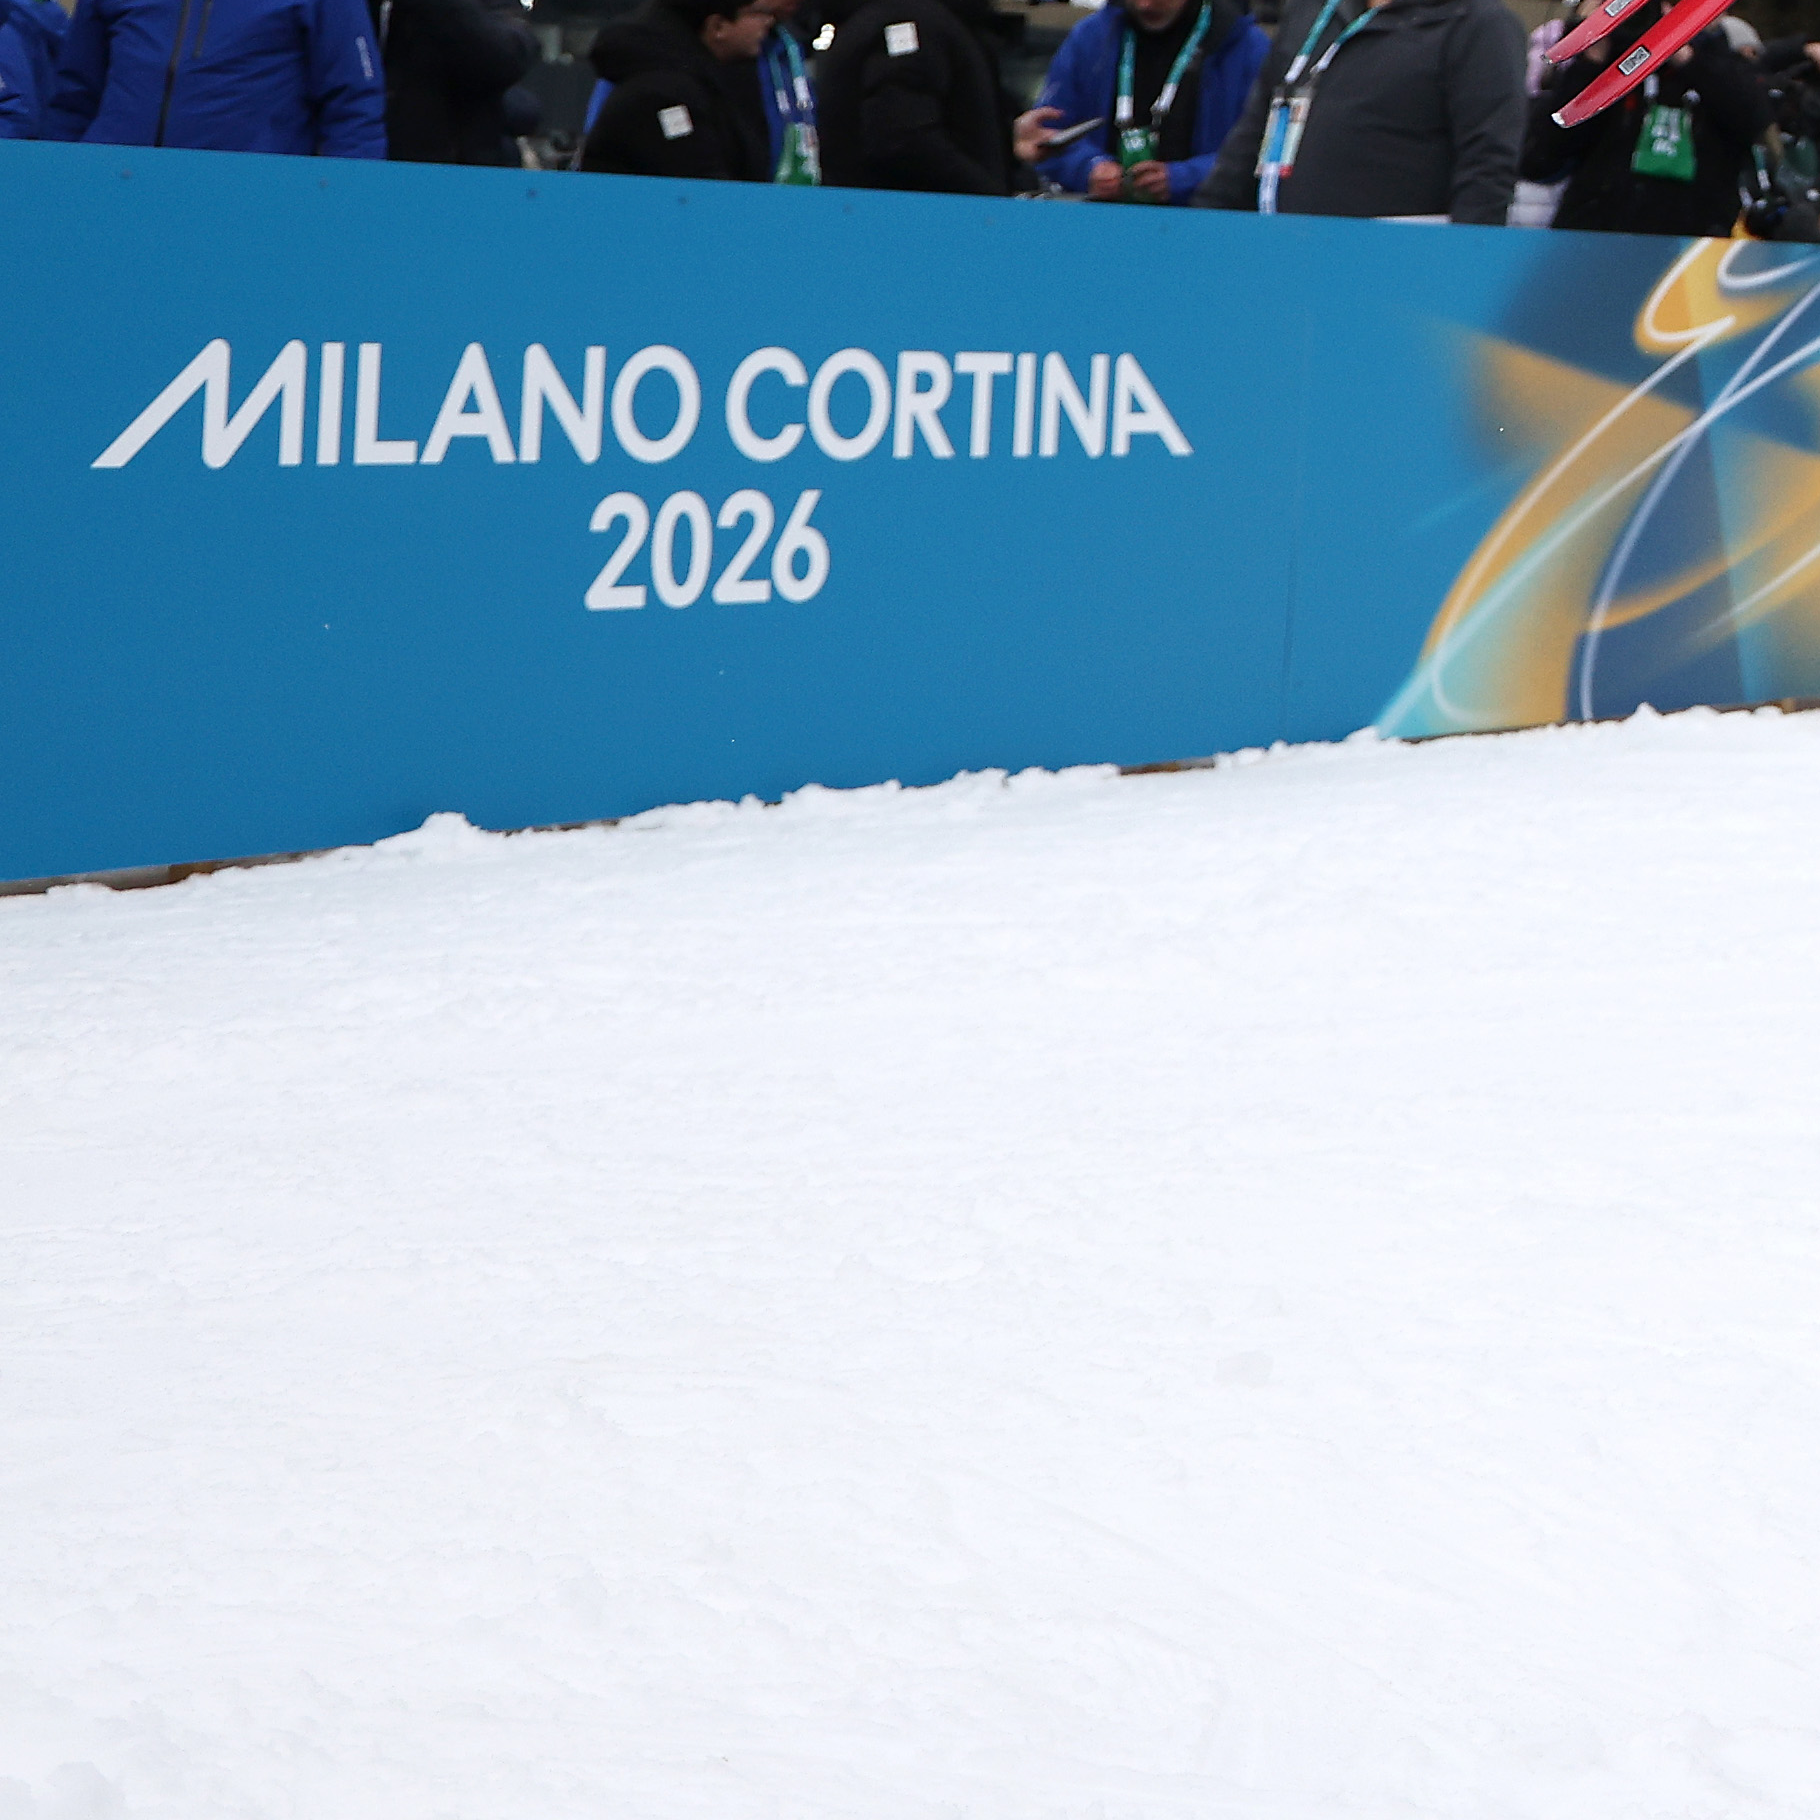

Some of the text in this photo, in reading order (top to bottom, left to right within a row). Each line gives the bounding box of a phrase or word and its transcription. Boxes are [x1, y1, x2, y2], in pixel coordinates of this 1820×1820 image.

[90, 338, 1194, 469] MILANO CORTINA
[584, 488, 831, 612] 2026
